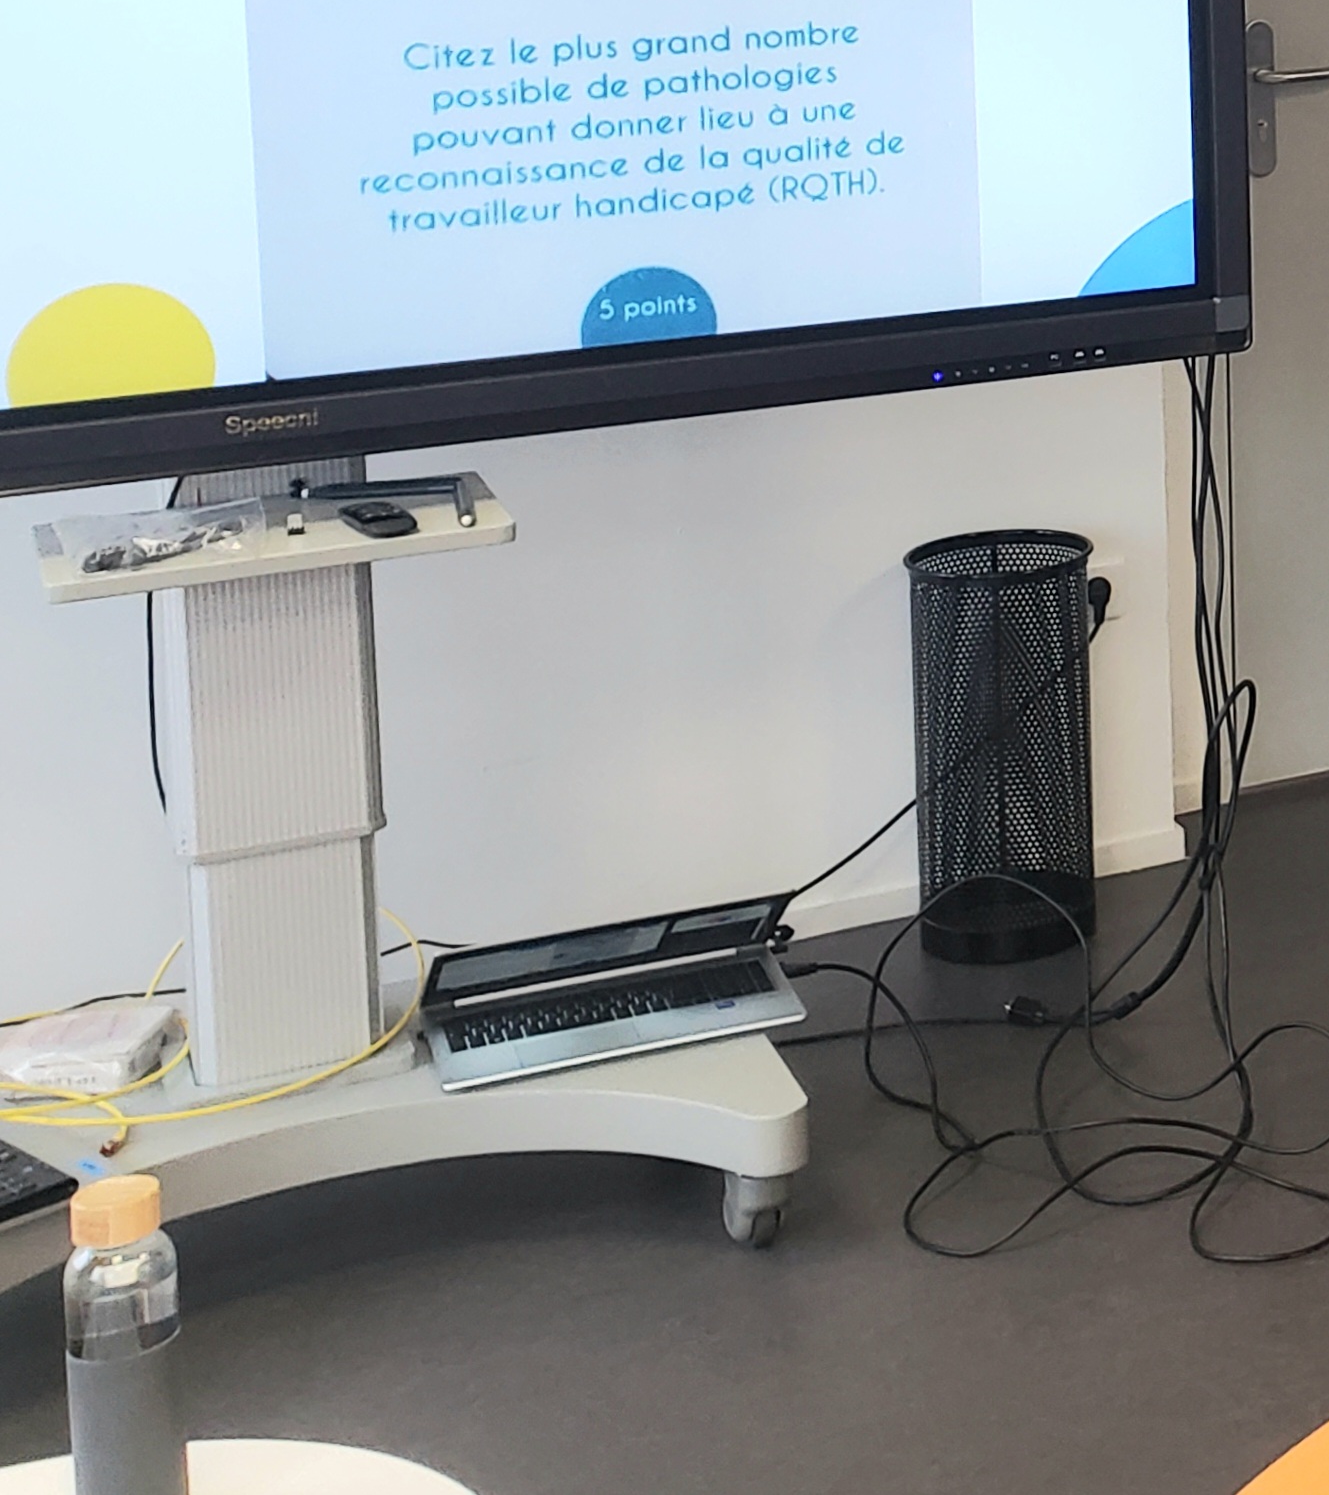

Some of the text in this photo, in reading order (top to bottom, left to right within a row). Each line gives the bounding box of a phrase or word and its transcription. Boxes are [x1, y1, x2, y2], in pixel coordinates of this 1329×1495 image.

[403, 21, 861, 72] Citez le plus grand nombre
[432, 62, 839, 115] possible de pathologies
[412, 100, 857, 157] pouvant donner lieu à une
[359, 130, 906, 196] reconnaissance de la qualité de
[388, 170, 887, 233] travailleur handicapé (RQTH).
[598, 293, 699, 323] 5 points
